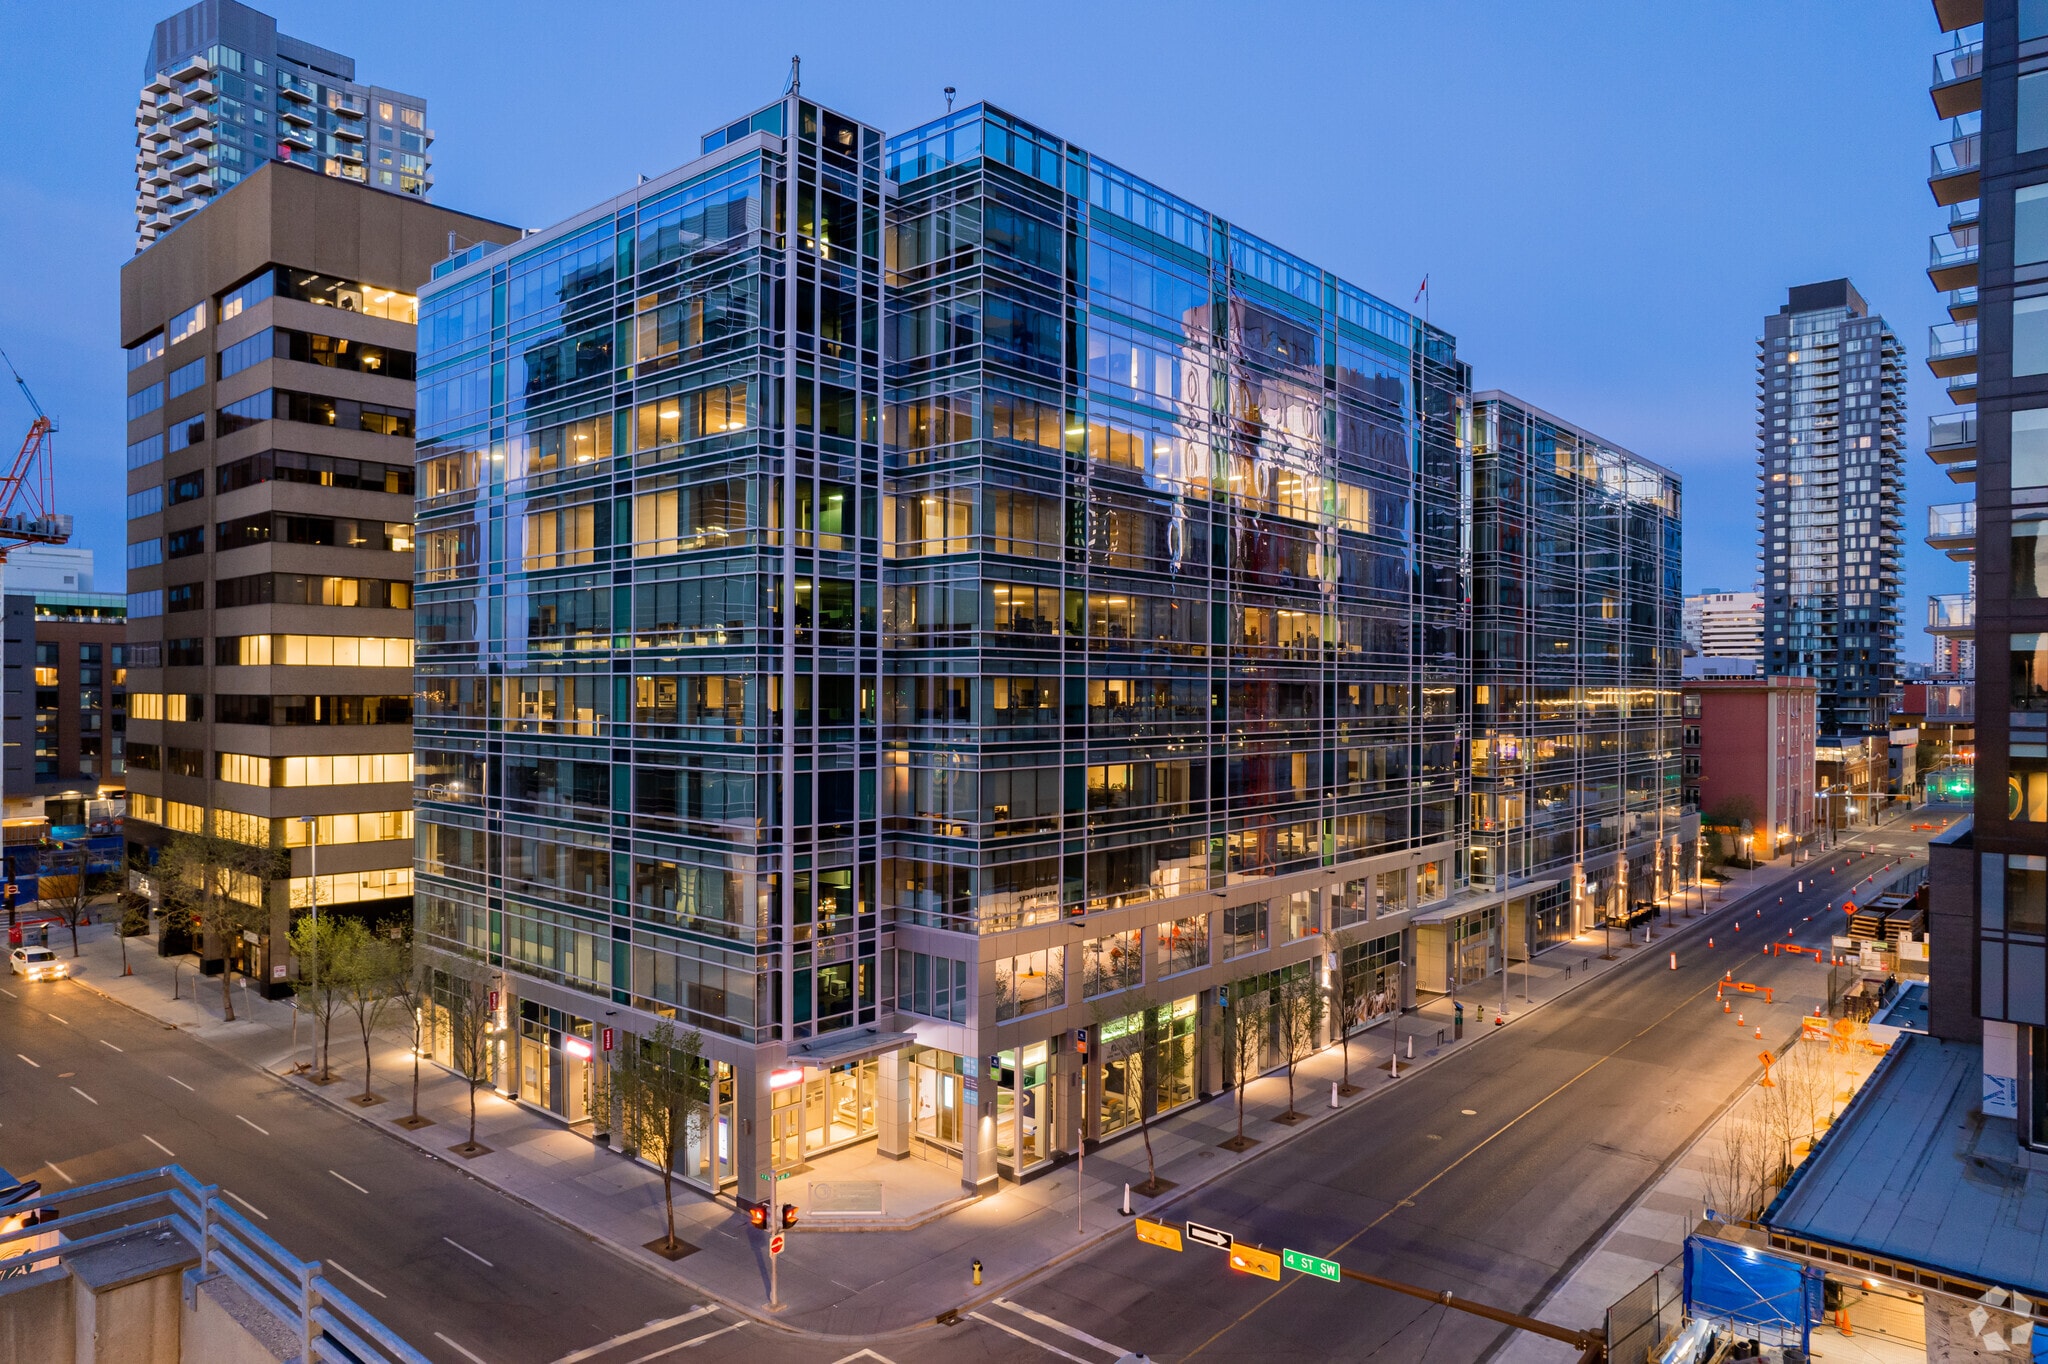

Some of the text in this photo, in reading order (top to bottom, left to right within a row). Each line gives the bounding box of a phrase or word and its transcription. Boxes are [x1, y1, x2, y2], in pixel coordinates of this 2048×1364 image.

[1287, 1254, 1335, 1276] 4 ST SW
